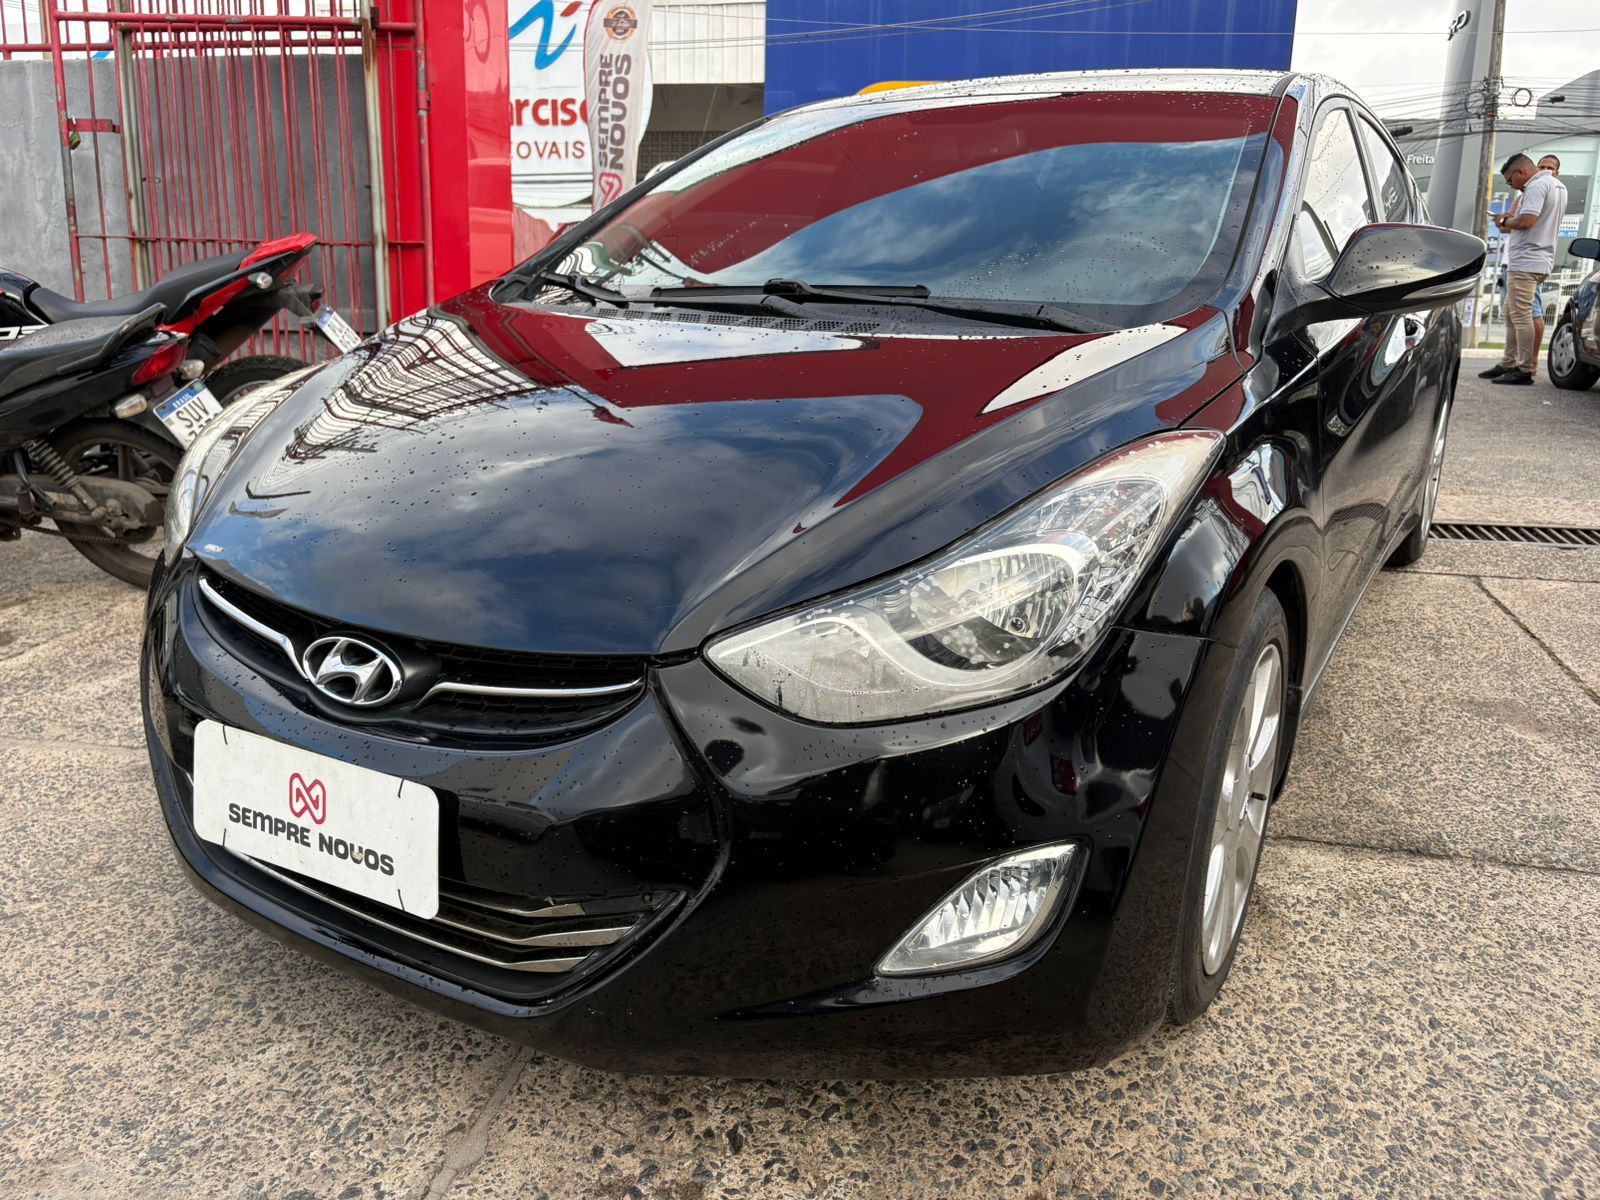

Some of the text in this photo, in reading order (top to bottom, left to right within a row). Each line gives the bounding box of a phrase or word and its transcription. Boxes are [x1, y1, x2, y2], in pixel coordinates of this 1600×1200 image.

[510, 97, 589, 127] rcis
[511, 140, 585, 160] OVAIS
[175, 396, 210, 429] SUV
[228, 802, 311, 848] SEMPRE
